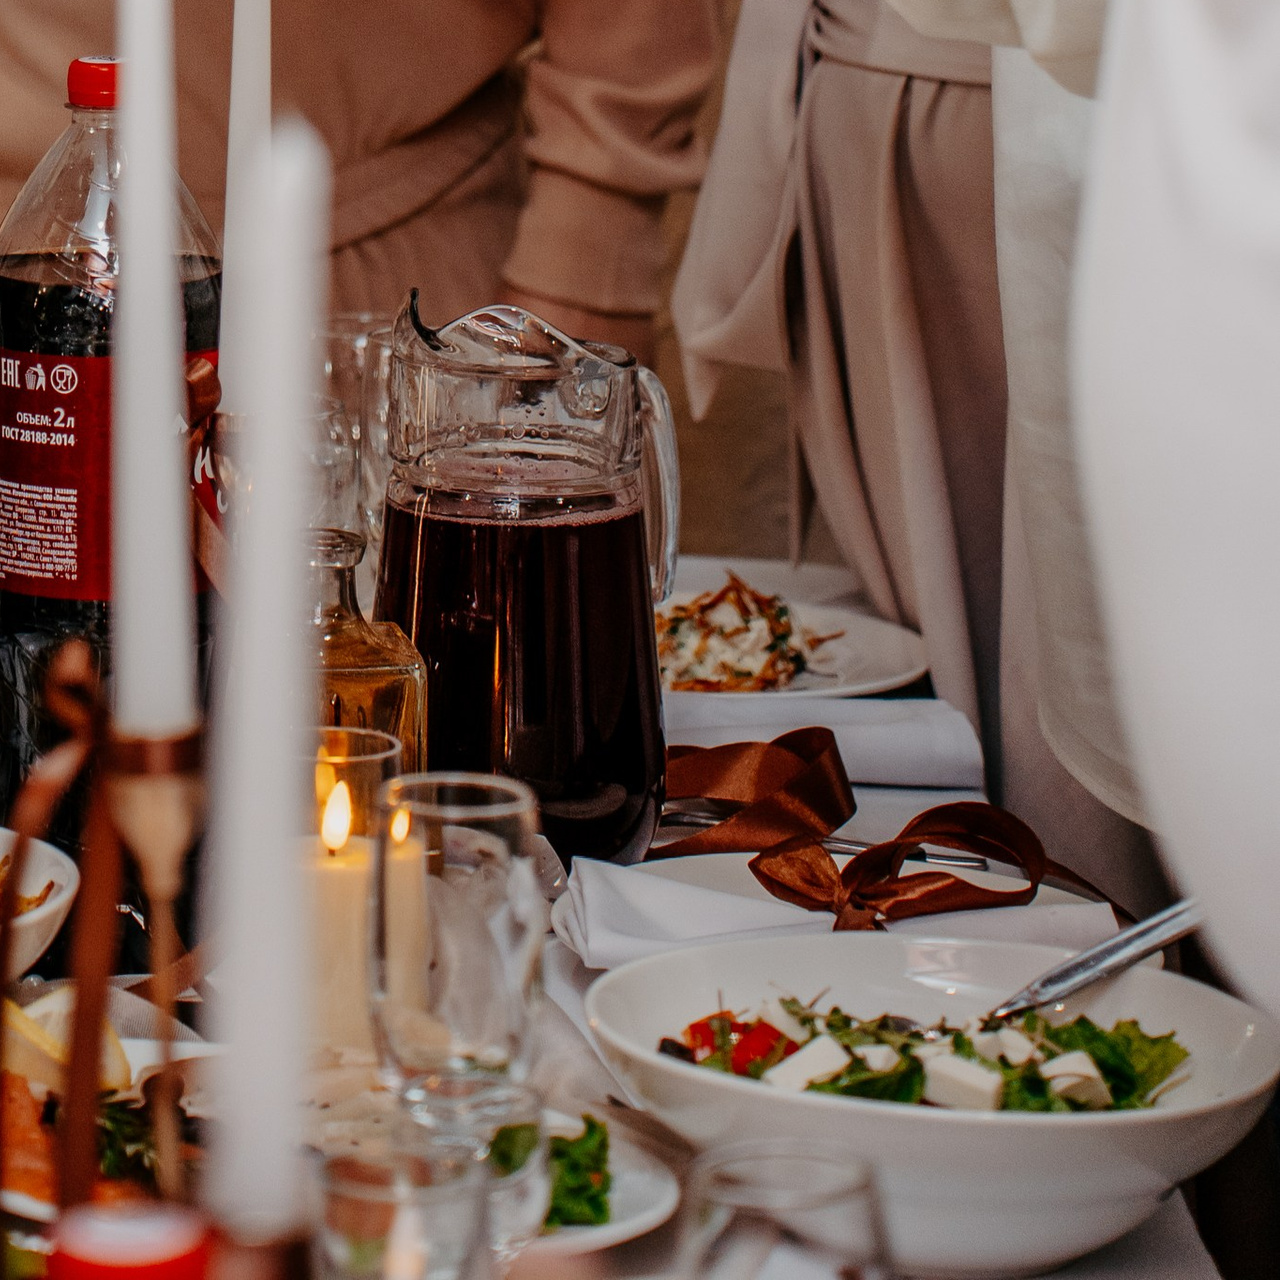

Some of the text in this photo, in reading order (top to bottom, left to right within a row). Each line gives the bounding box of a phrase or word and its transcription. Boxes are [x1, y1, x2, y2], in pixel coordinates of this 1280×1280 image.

[16, 411, 52, 427] ОБЪЕМ:
[1, 425, 75, 447] ГОСТ 28188-2014
